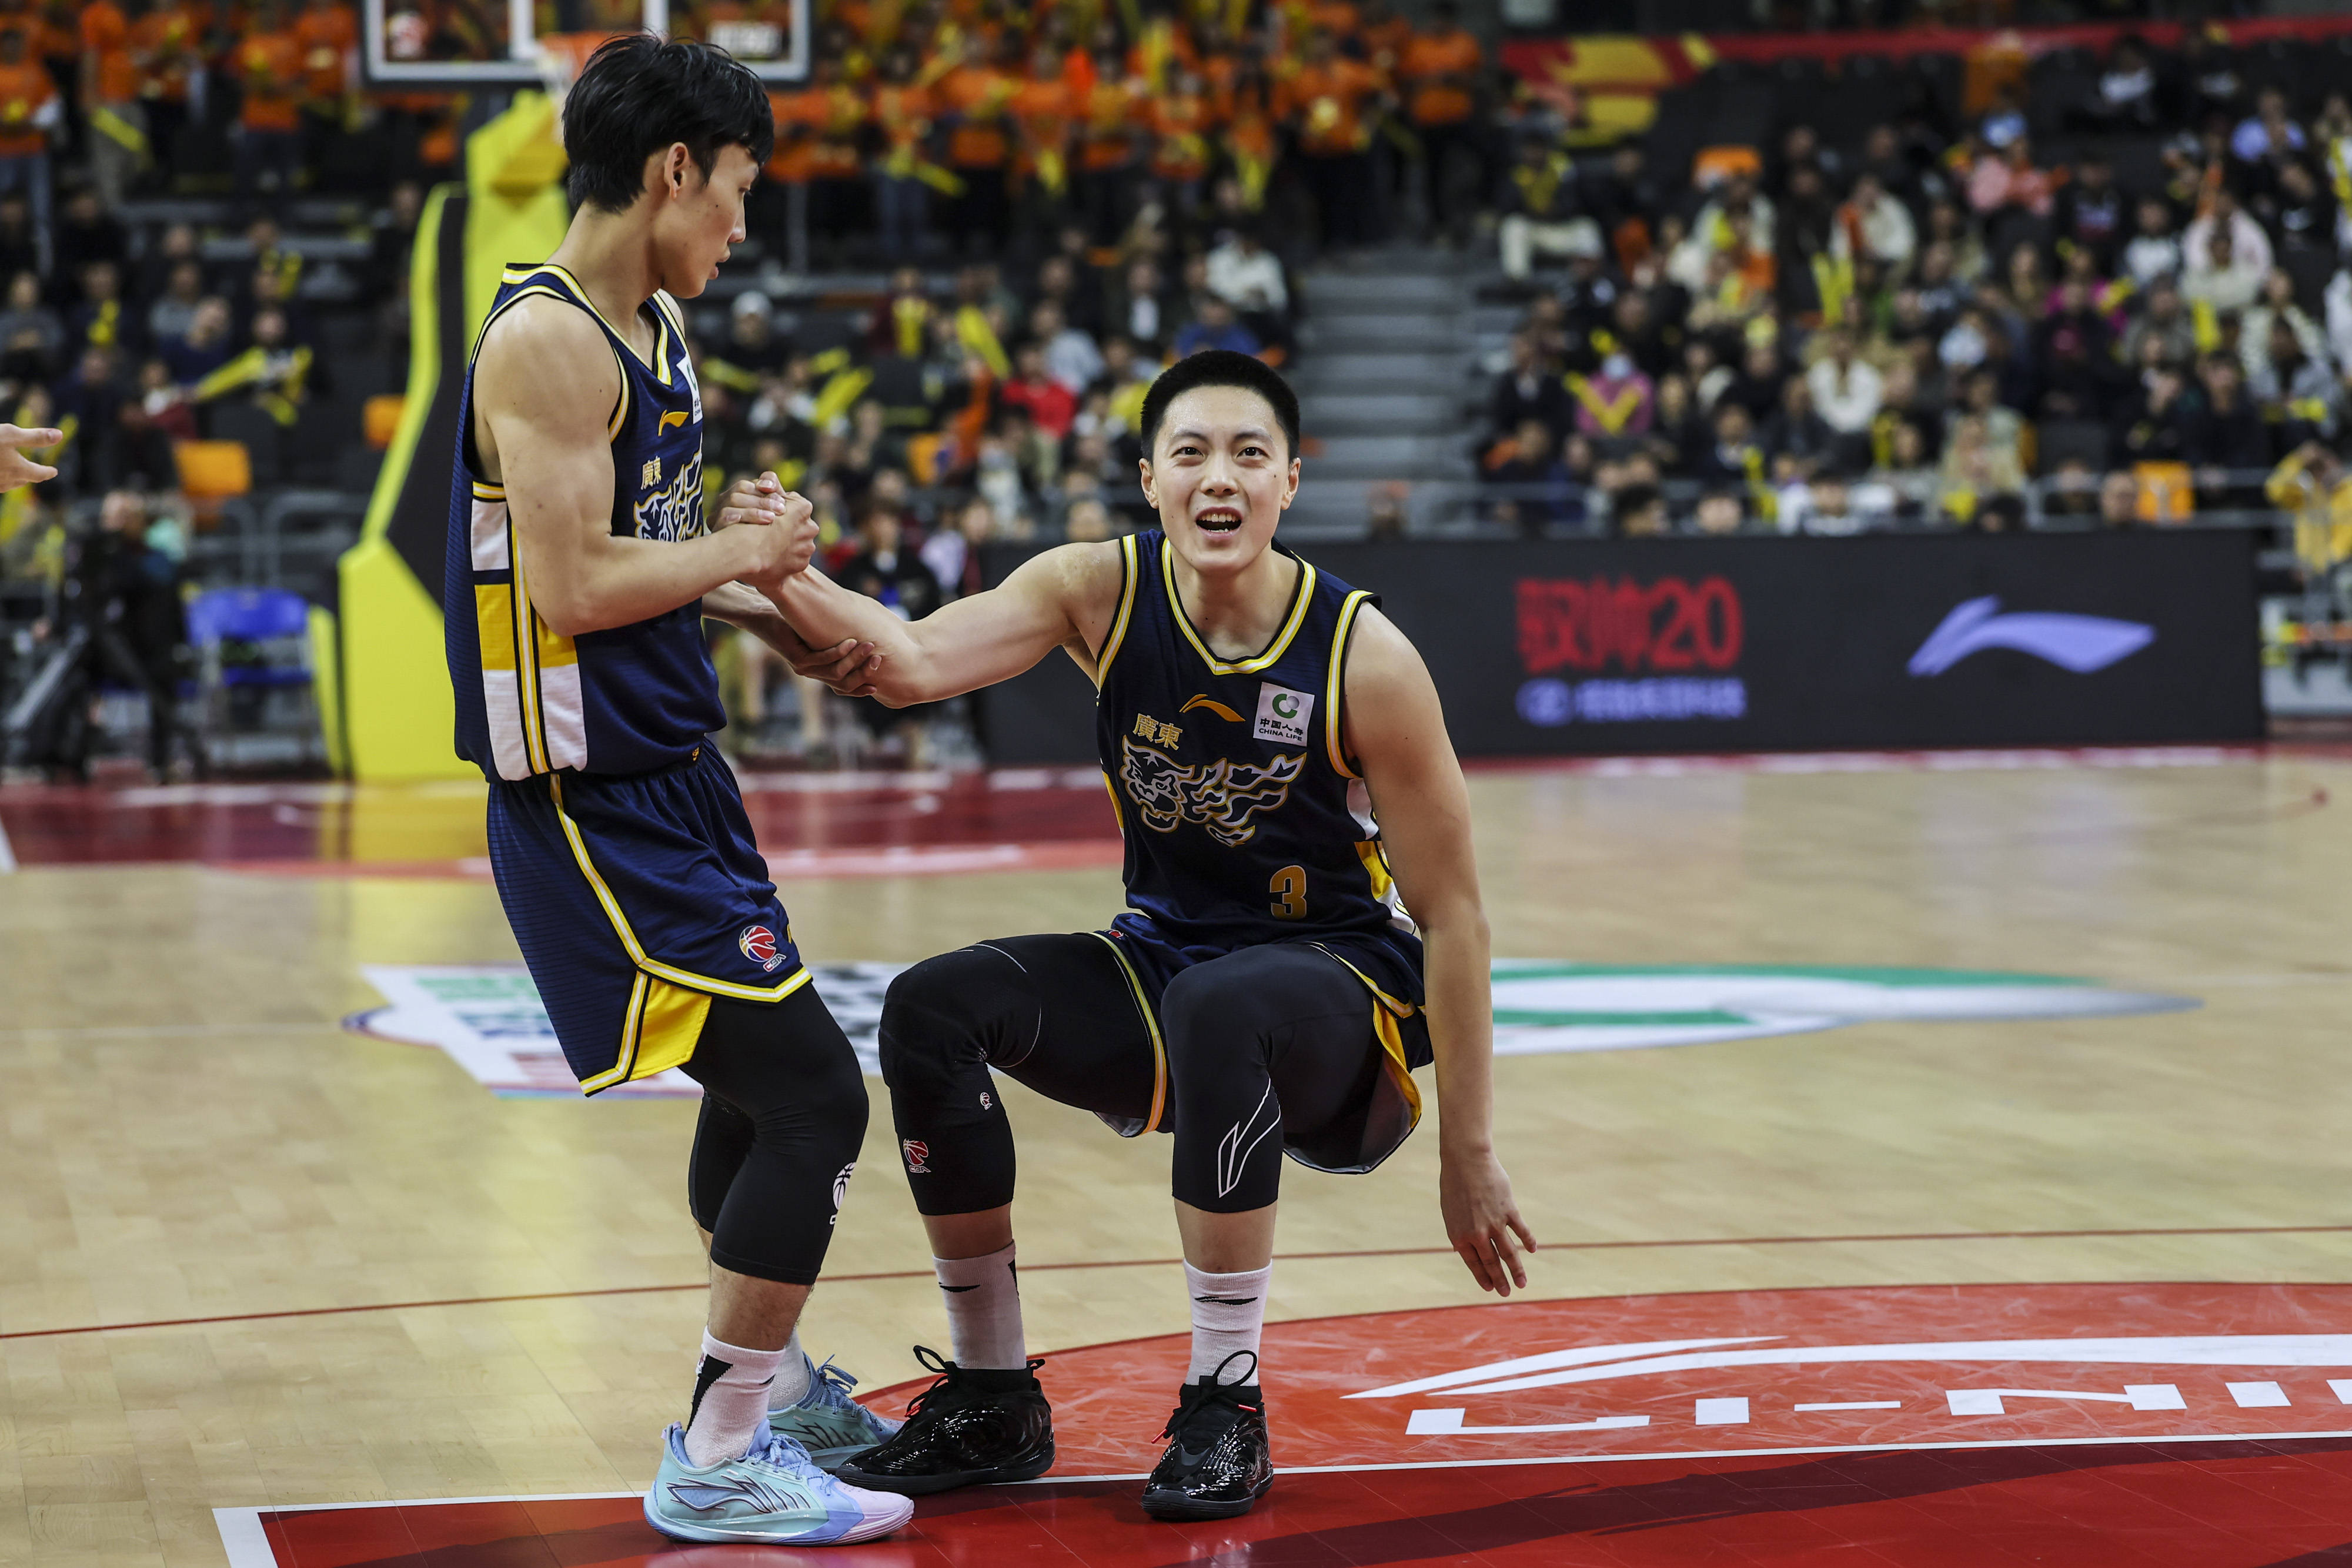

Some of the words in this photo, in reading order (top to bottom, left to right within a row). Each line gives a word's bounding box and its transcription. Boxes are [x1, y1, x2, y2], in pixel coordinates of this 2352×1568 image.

[1132, 713, 1183, 751] 廣東
[1258, 728, 1284, 737] CHINA
[1285, 733, 1303, 742] LIFE
[1259, 718, 1304, 735] 中国人寿
[1269, 865, 1307, 922] 3
[763, 953, 787, 972] CBA
